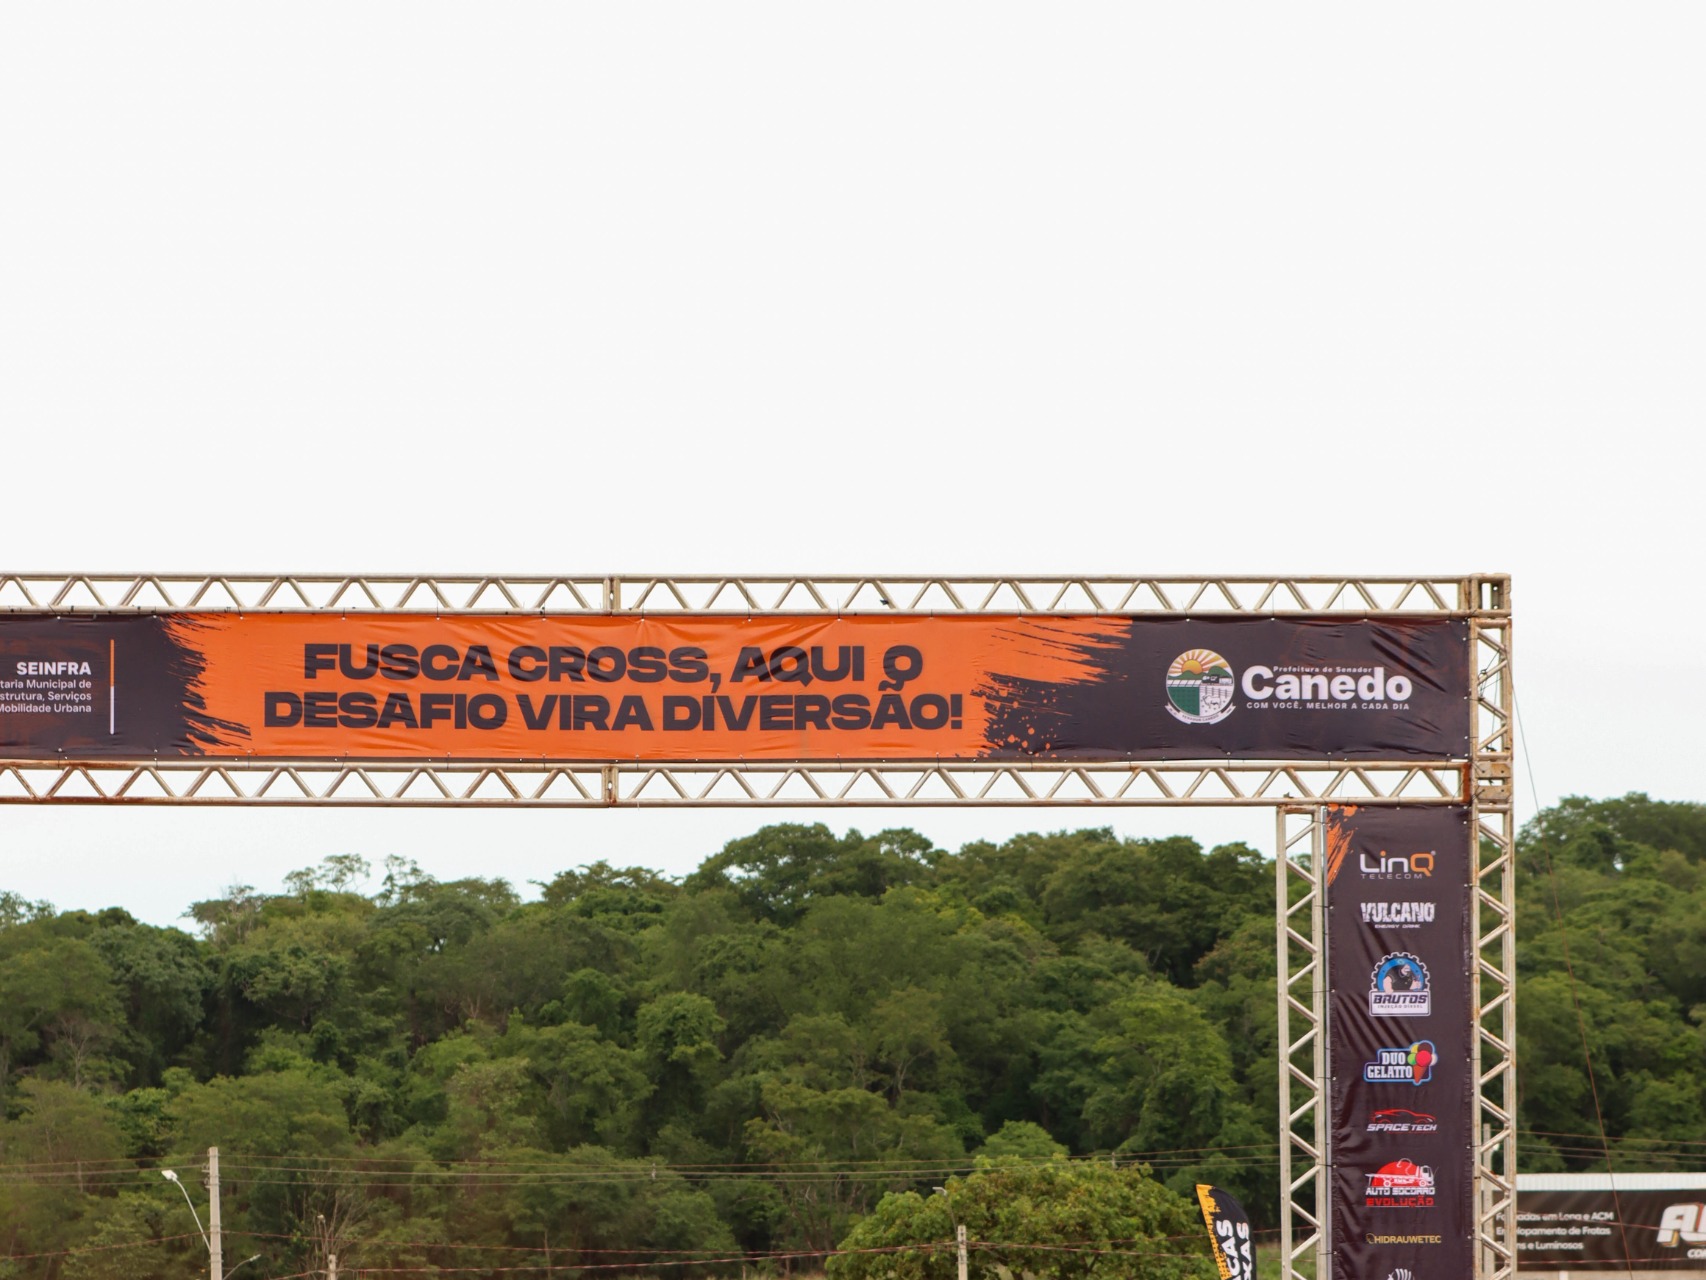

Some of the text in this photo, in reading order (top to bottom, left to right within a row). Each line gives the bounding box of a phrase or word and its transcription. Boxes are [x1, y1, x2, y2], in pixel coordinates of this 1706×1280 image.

[16, 661, 92, 676] SEINFRA
[303, 643, 924, 693] FUSCA CROSS, AQUI O
[1273, 665, 1319, 673] Prefeitura
[26, 679, 77, 690] Municipal
[78, 679, 92, 689] de
[1241, 665, 1413, 701] Canedo
[47, 691, 92, 703] Serviços
[53, 703, 92, 713] Urbana
[263, 681, 963, 732] DESAFIO VIRA DIVERSÃO!
[1272, 701, 1303, 710] VOCÊ,
[1360, 850, 1434, 877] LinQ
[1360, 902, 1437, 922] VULCANO
[1373, 994, 1428, 1004] BRUTOS
[1381, 1052, 1406, 1065] DUO
[1367, 1065, 1413, 1079] GELATTO
[1366, 1123, 1438, 1132] SPACE TECH
[1365, 1187, 1436, 1196] AUTO SOCORRO
[1366, 1196, 1435, 1207] EVOLUÇÃO
[1559, 1212, 1582, 1221] Lona
[1591, 1212, 1615, 1220] ACM
[1568, 1227, 1581, 1235] de
[1374, 1235, 1442, 1244] HIDRAUWETEC
[1535, 1240, 1584, 1250] Luminosos
